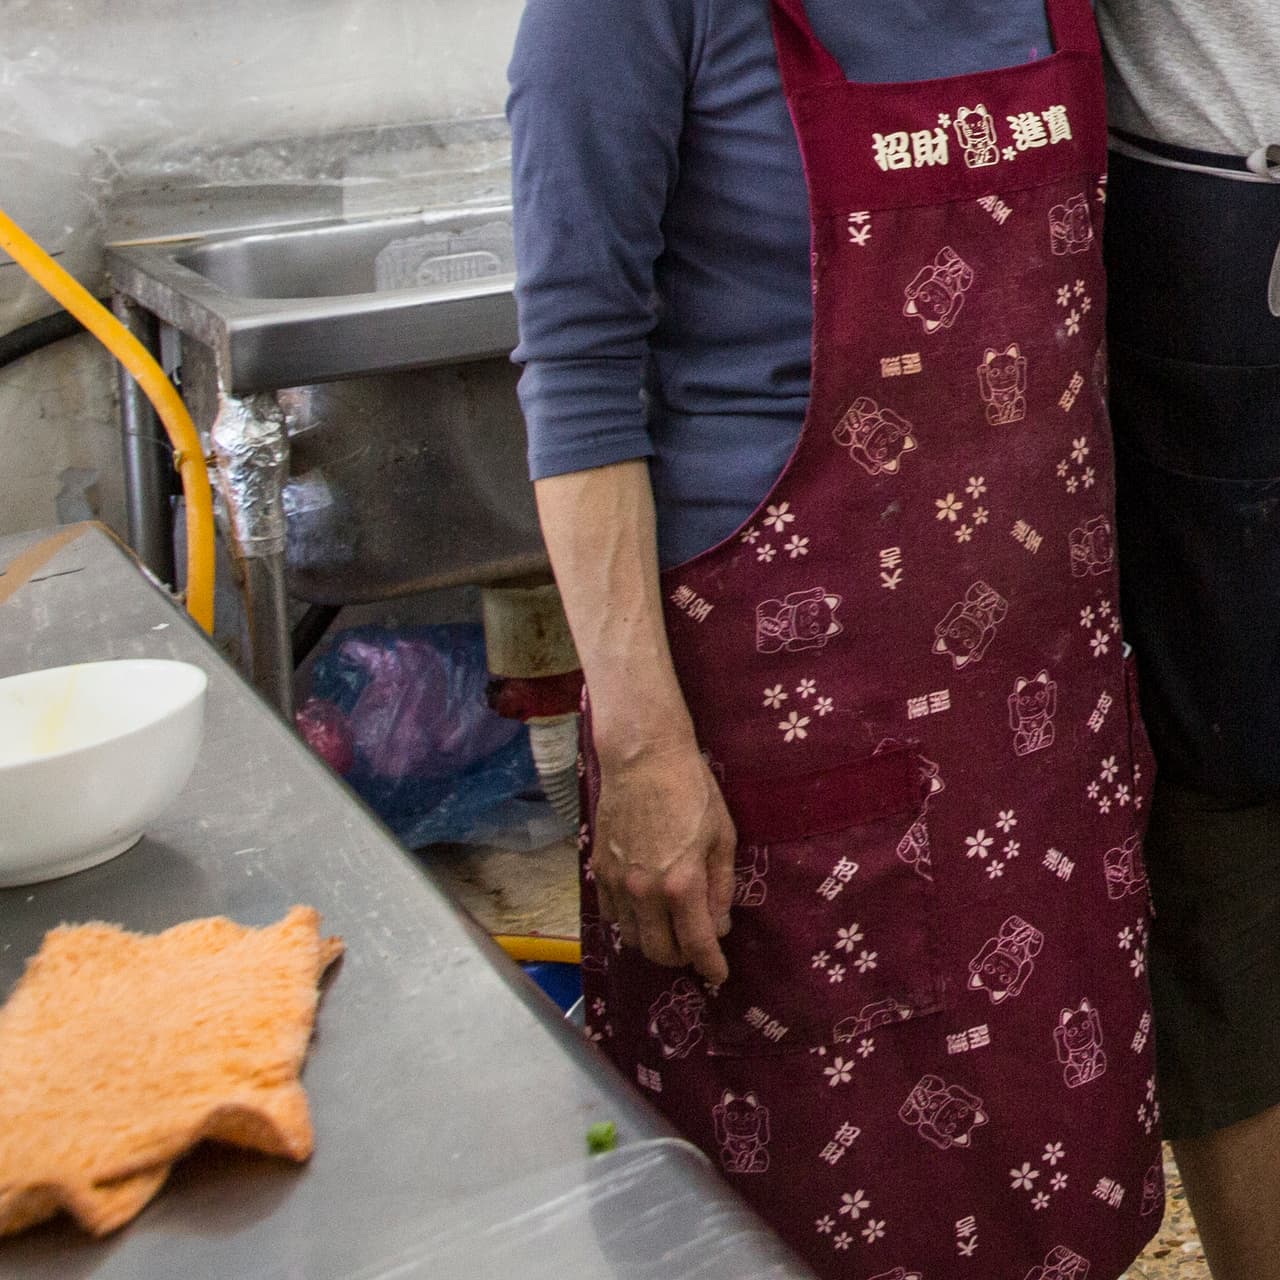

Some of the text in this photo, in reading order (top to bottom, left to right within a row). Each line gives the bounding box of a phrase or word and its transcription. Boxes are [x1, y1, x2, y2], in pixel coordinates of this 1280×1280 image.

[872, 104, 1073, 171] 招財 進寶
[1058, 370, 1085, 413] 招財
[879, 546, 903, 590] 大吉
[1087, 690, 1113, 734] 招財
[816, 855, 860, 901] 招財
[819, 1120, 862, 1165] 招財
[955, 1215, 979, 1257] 大吉
